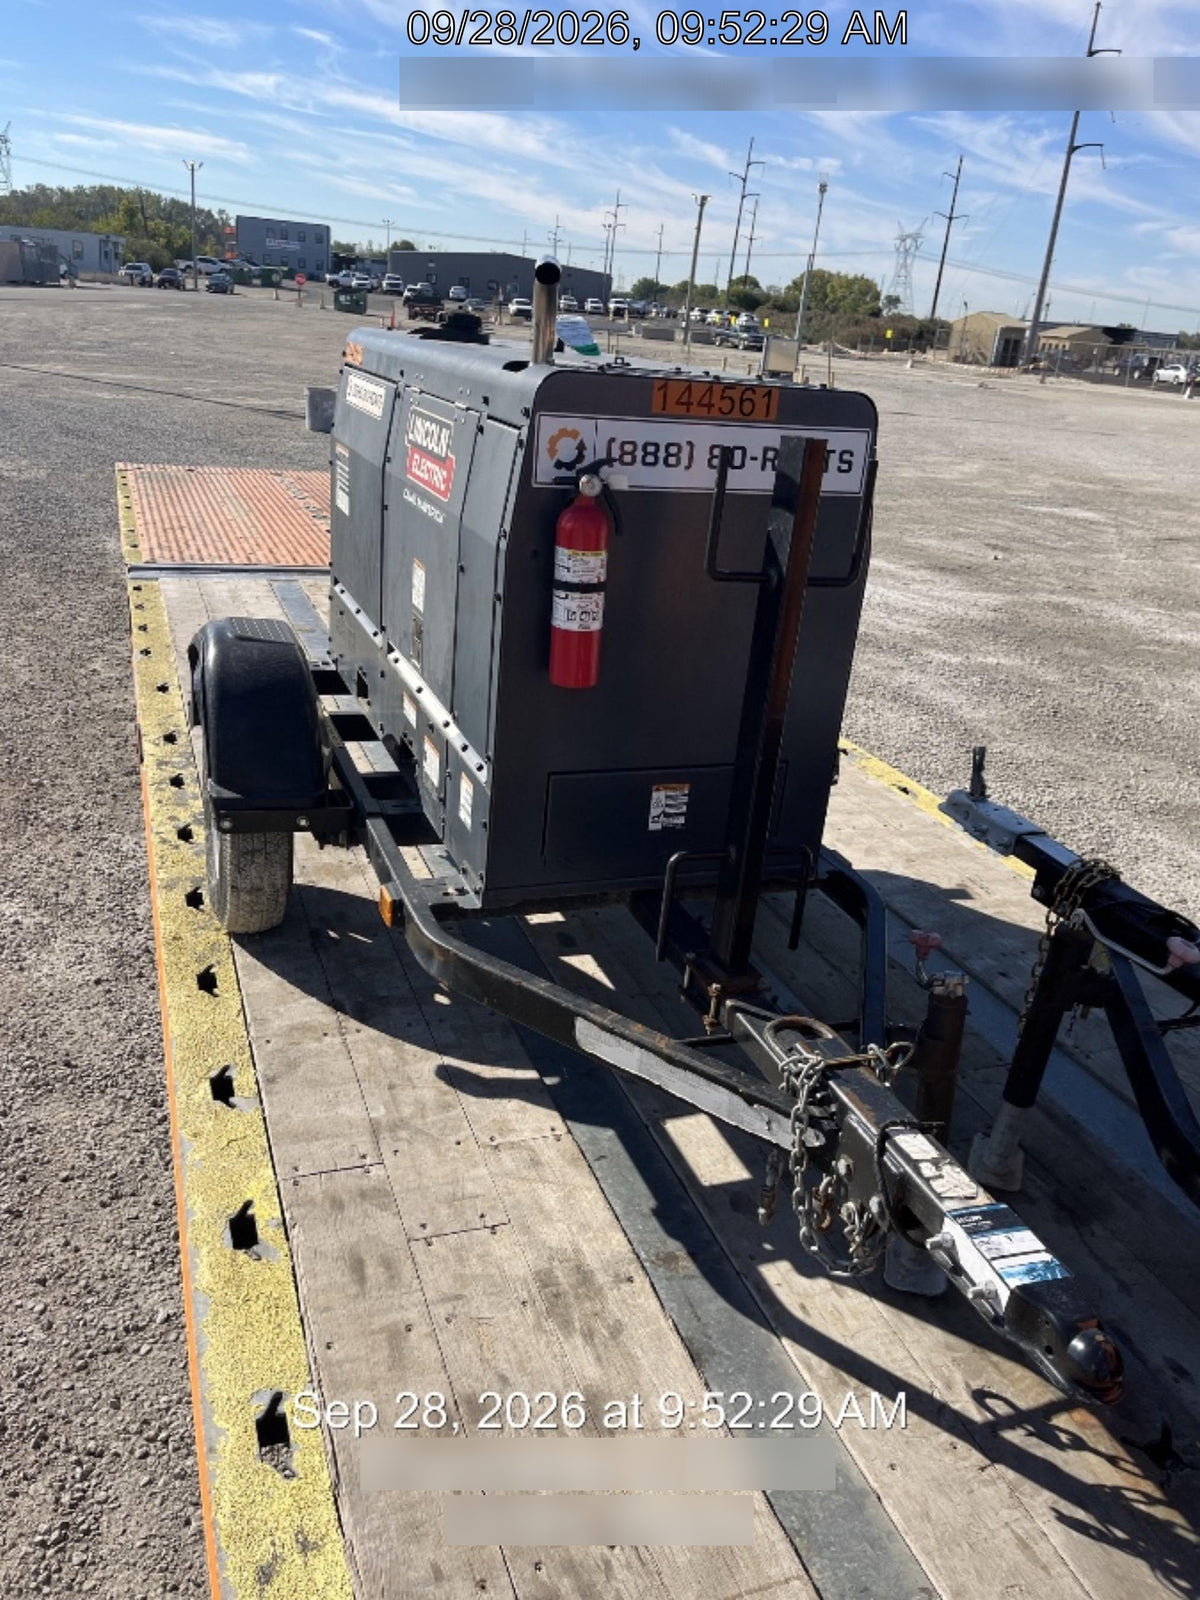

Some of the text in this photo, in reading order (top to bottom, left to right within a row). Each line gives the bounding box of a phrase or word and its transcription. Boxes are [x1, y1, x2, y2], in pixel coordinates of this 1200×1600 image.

[656, 381, 773, 418] 144561
[408, 413, 451, 458] LINCOLN
[412, 453, 448, 491] ELECTRIC
[605, 437, 855, 474] (888) 80-RTS
